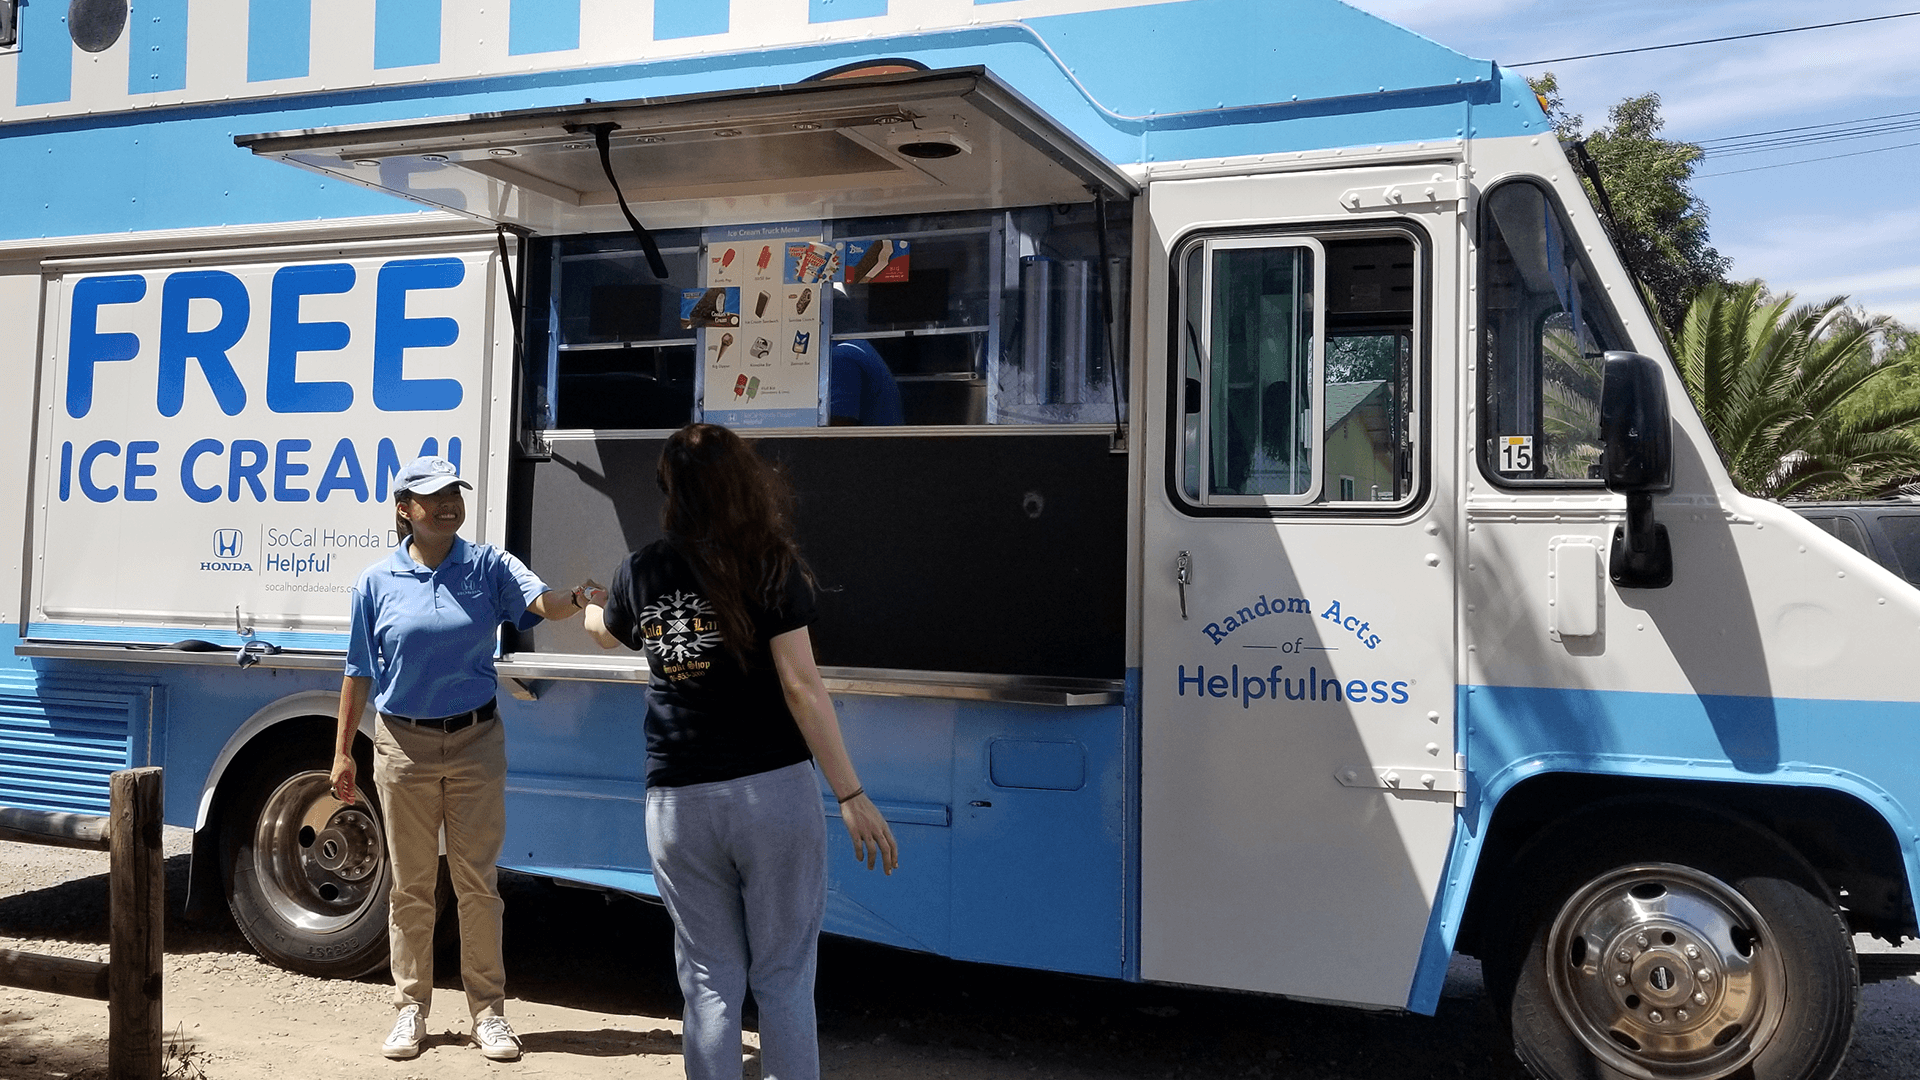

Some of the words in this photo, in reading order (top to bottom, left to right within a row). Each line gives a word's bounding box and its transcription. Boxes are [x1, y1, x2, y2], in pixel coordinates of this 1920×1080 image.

[762, 227, 780, 235] Truck
[780, 226, 800, 234] Menu
[66, 257, 466, 419] FREE
[1503, 446, 1531, 470] 15
[60, 441, 159, 503] ICE
[267, 528, 317, 548] SoCal
[323, 528, 380, 548] Honda
[200, 562, 253, 572] HONDA
[266, 552, 331, 578] Helpful
[1202, 595, 1311, 645] Random
[1321, 600, 1382, 650] Acts
[1281, 637, 1304, 654] of
[1178, 664, 1410, 709] Helpfulness
